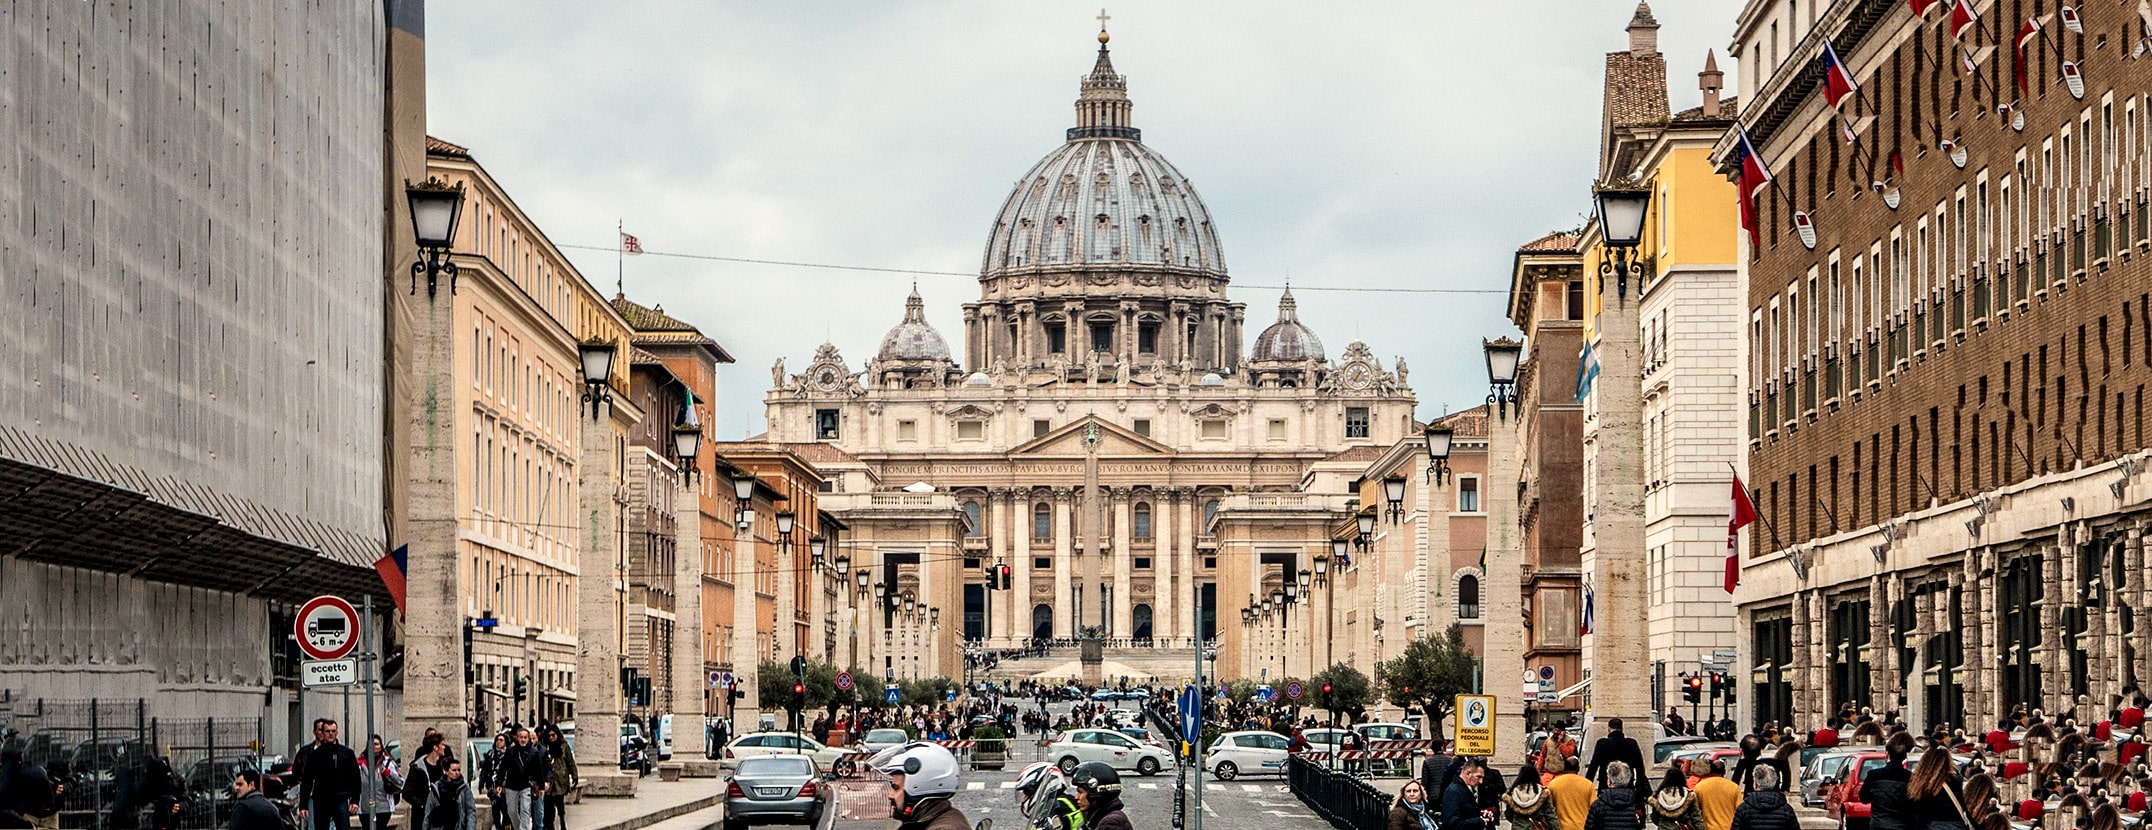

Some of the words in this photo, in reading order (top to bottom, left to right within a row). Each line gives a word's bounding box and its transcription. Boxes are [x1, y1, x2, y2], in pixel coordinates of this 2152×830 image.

[881, 465, 931, 474] HONOREM
[933, 465, 982, 474] PRINCIPIS
[1119, 465, 1169, 473] ROMANVS
[320, 637, 325, 646] 6
[311, 664, 347, 673] eccetto
[320, 674, 340, 683] atac
